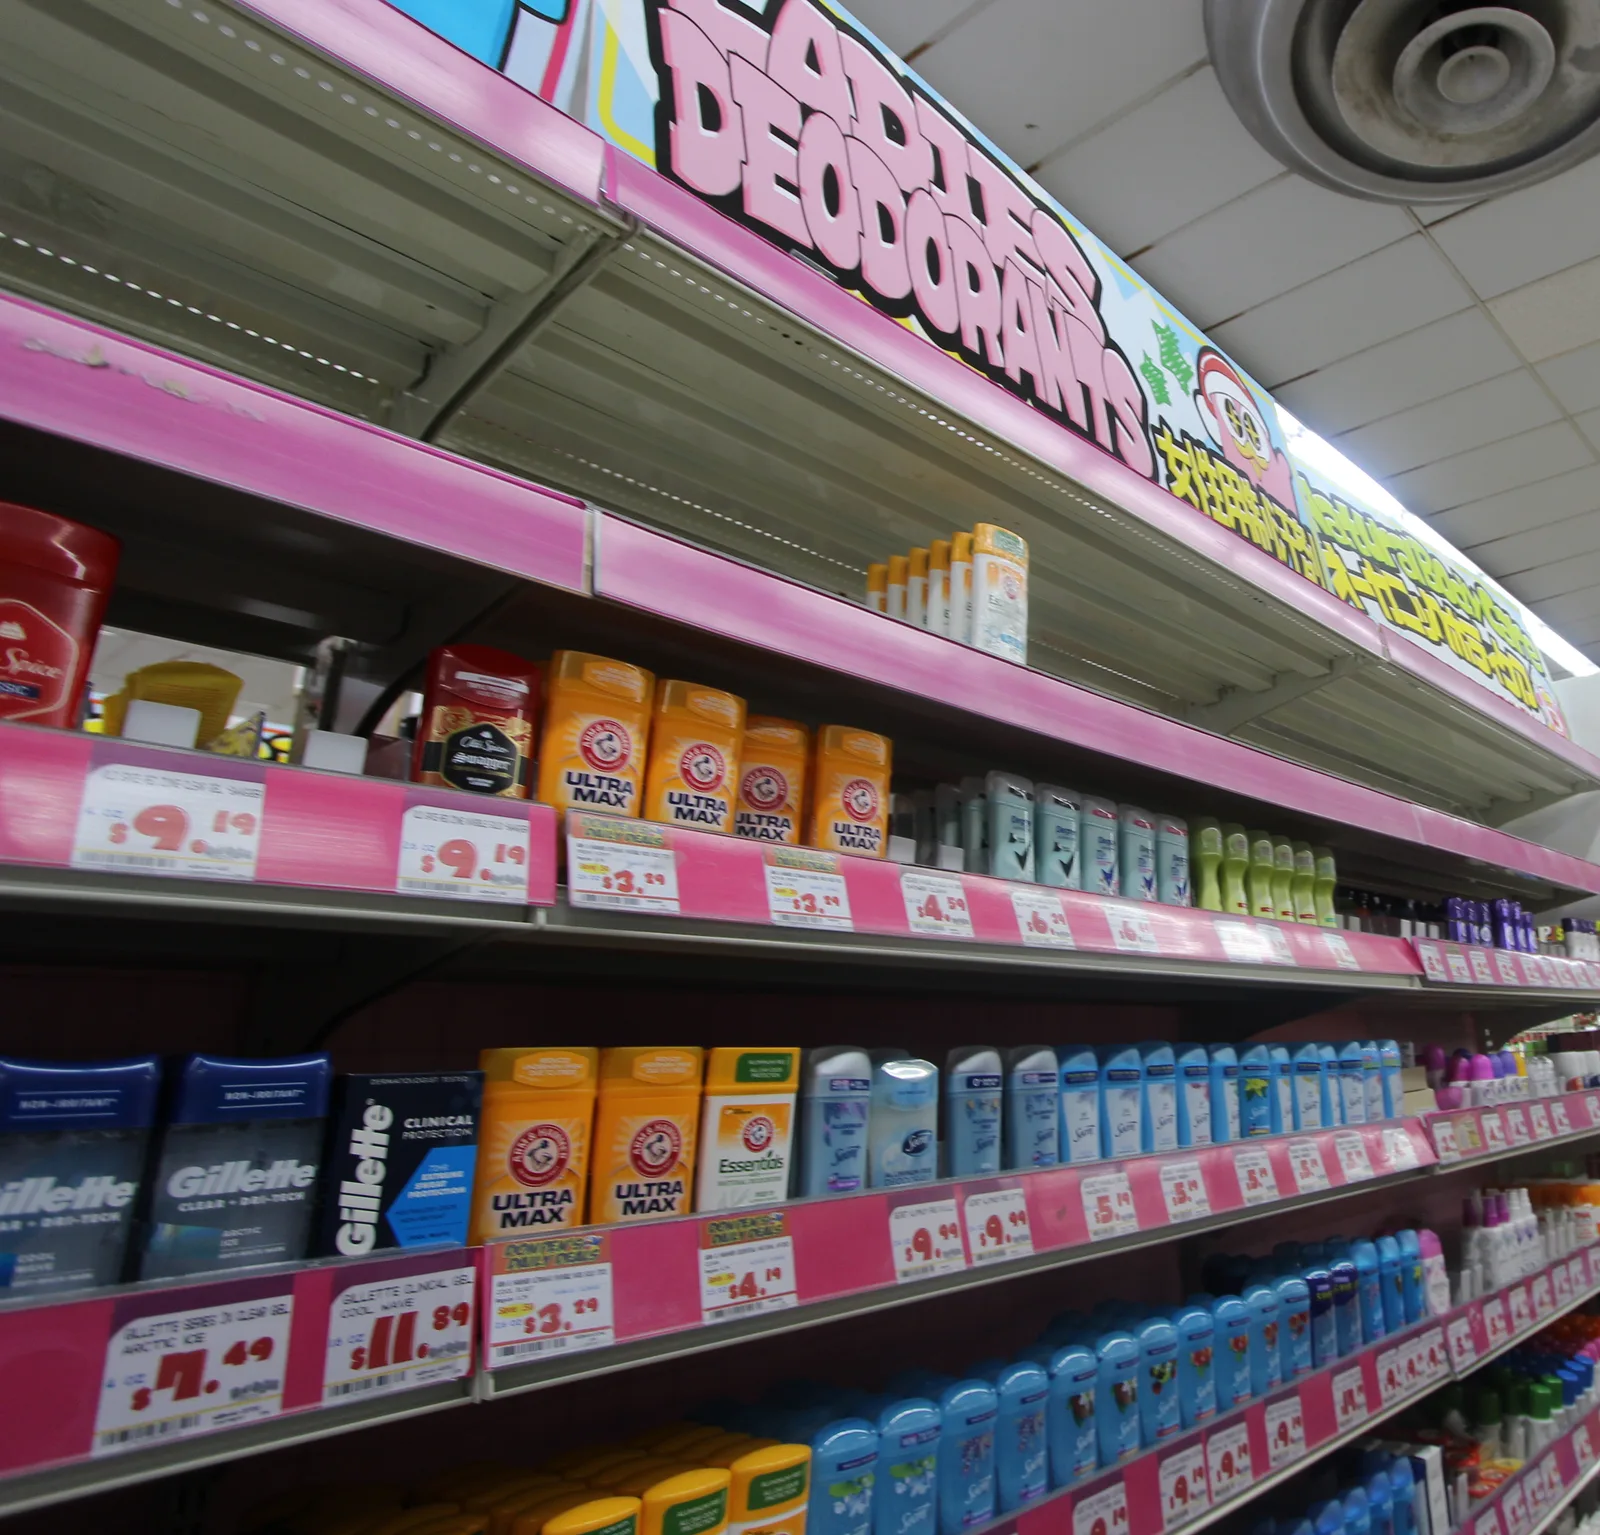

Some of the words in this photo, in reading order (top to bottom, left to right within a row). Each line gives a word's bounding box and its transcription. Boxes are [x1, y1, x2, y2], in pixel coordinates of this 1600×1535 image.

[657, 5, 1154, 479] DEODORANTS
[567, 771, 633, 796] ULTRA
[573, 788, 628, 808] MAX
[669, 792, 728, 814] ULTRA
[675, 807, 722, 826] MAX
[108, 804, 257, 854] $9.19
[737, 825, 785, 841] MAX
[834, 823, 881, 840] ULTRA
[840, 836, 877, 851] MAX
[420, 839, 526, 881] $9.19
[403, 1114, 474, 1129] CLINICAL
[401, 1127, 474, 1140] PROTECTION
[719, 1150, 784, 1173] Essentials
[167, 1159, 319, 1199] Gillette
[334, 1103, 395, 1257] Gillette
[615, 1180, 684, 1199] ULTRA
[177, 1199, 226, 1213] CLEAR
[492, 1188, 573, 1211] ULTRA
[622, 1197, 678, 1216] MAX
[500, 1207, 564, 1228] MAX
[979, 1210, 1027, 1247] $9.99
[905, 1222, 958, 1263] $9.99
[350, 1302, 470, 1370] $11.89
